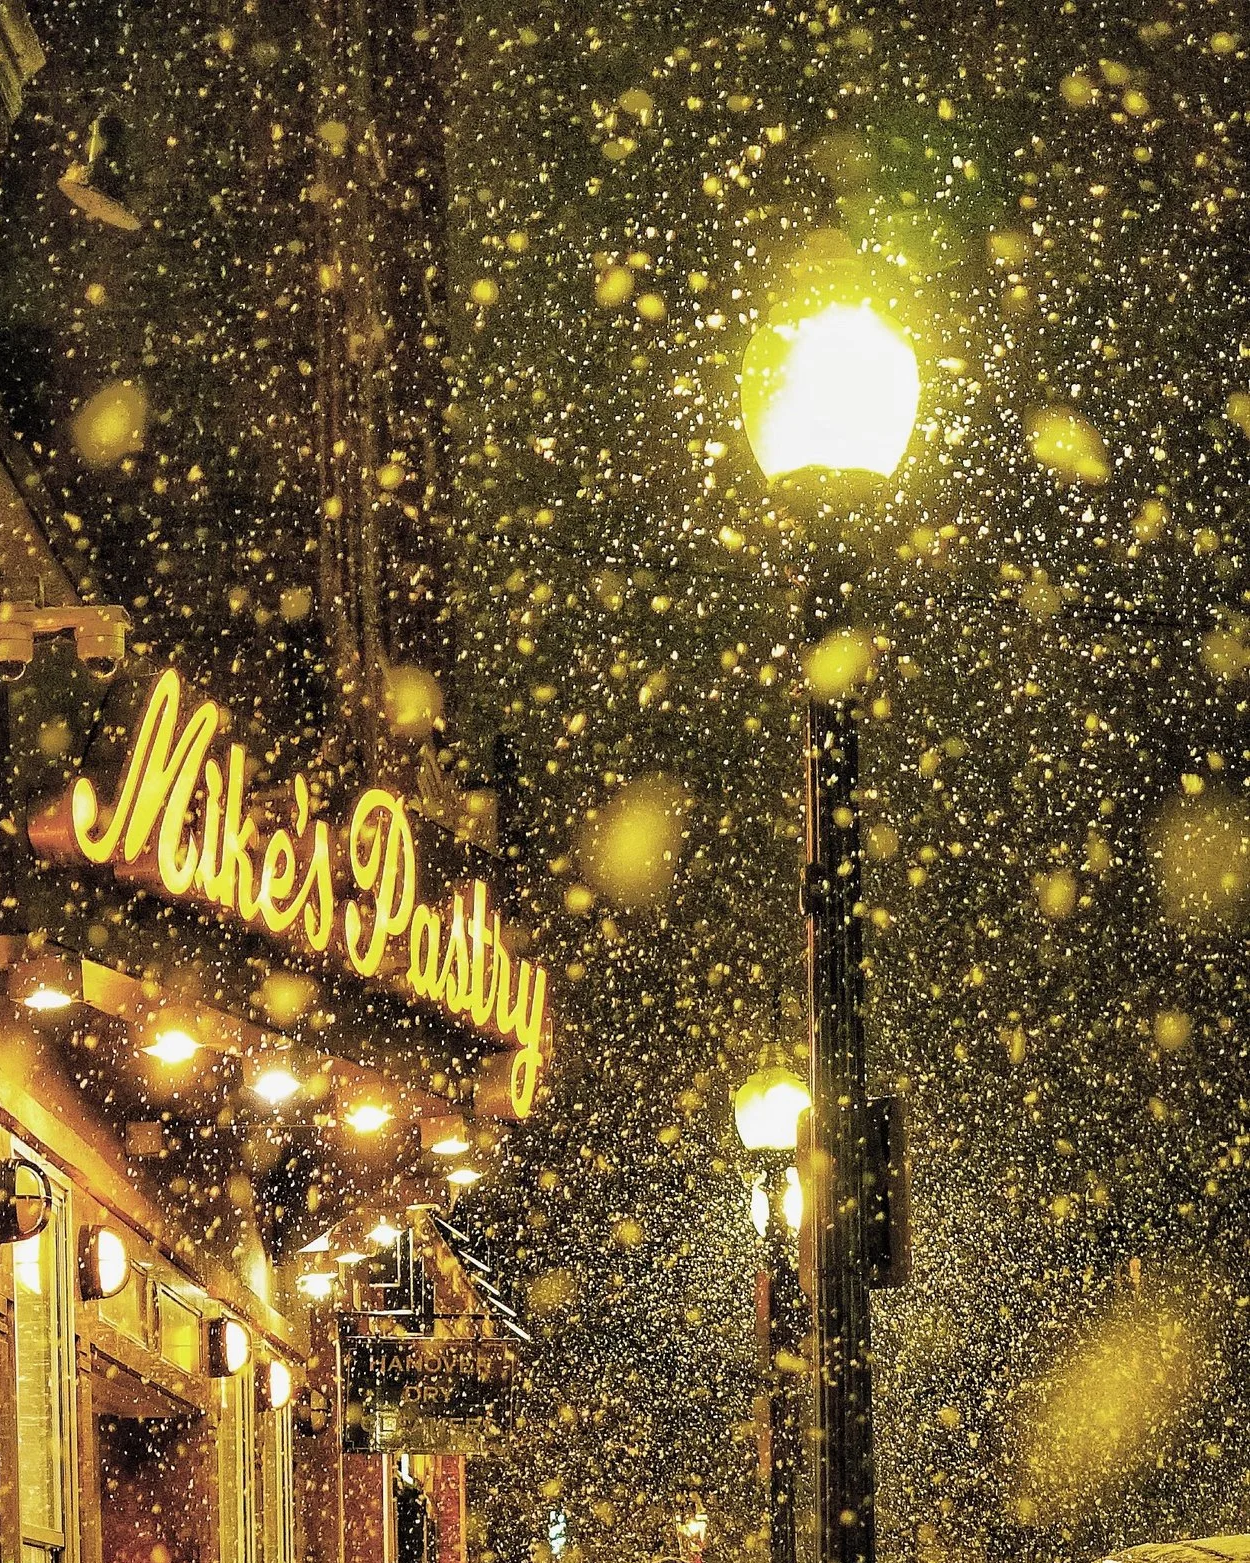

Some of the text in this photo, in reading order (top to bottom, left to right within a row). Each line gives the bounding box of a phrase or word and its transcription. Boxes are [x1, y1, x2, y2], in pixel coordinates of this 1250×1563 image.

[72, 668, 547, 1118] Mike's Pastry
[368, 1354, 492, 1375] HANOVER
